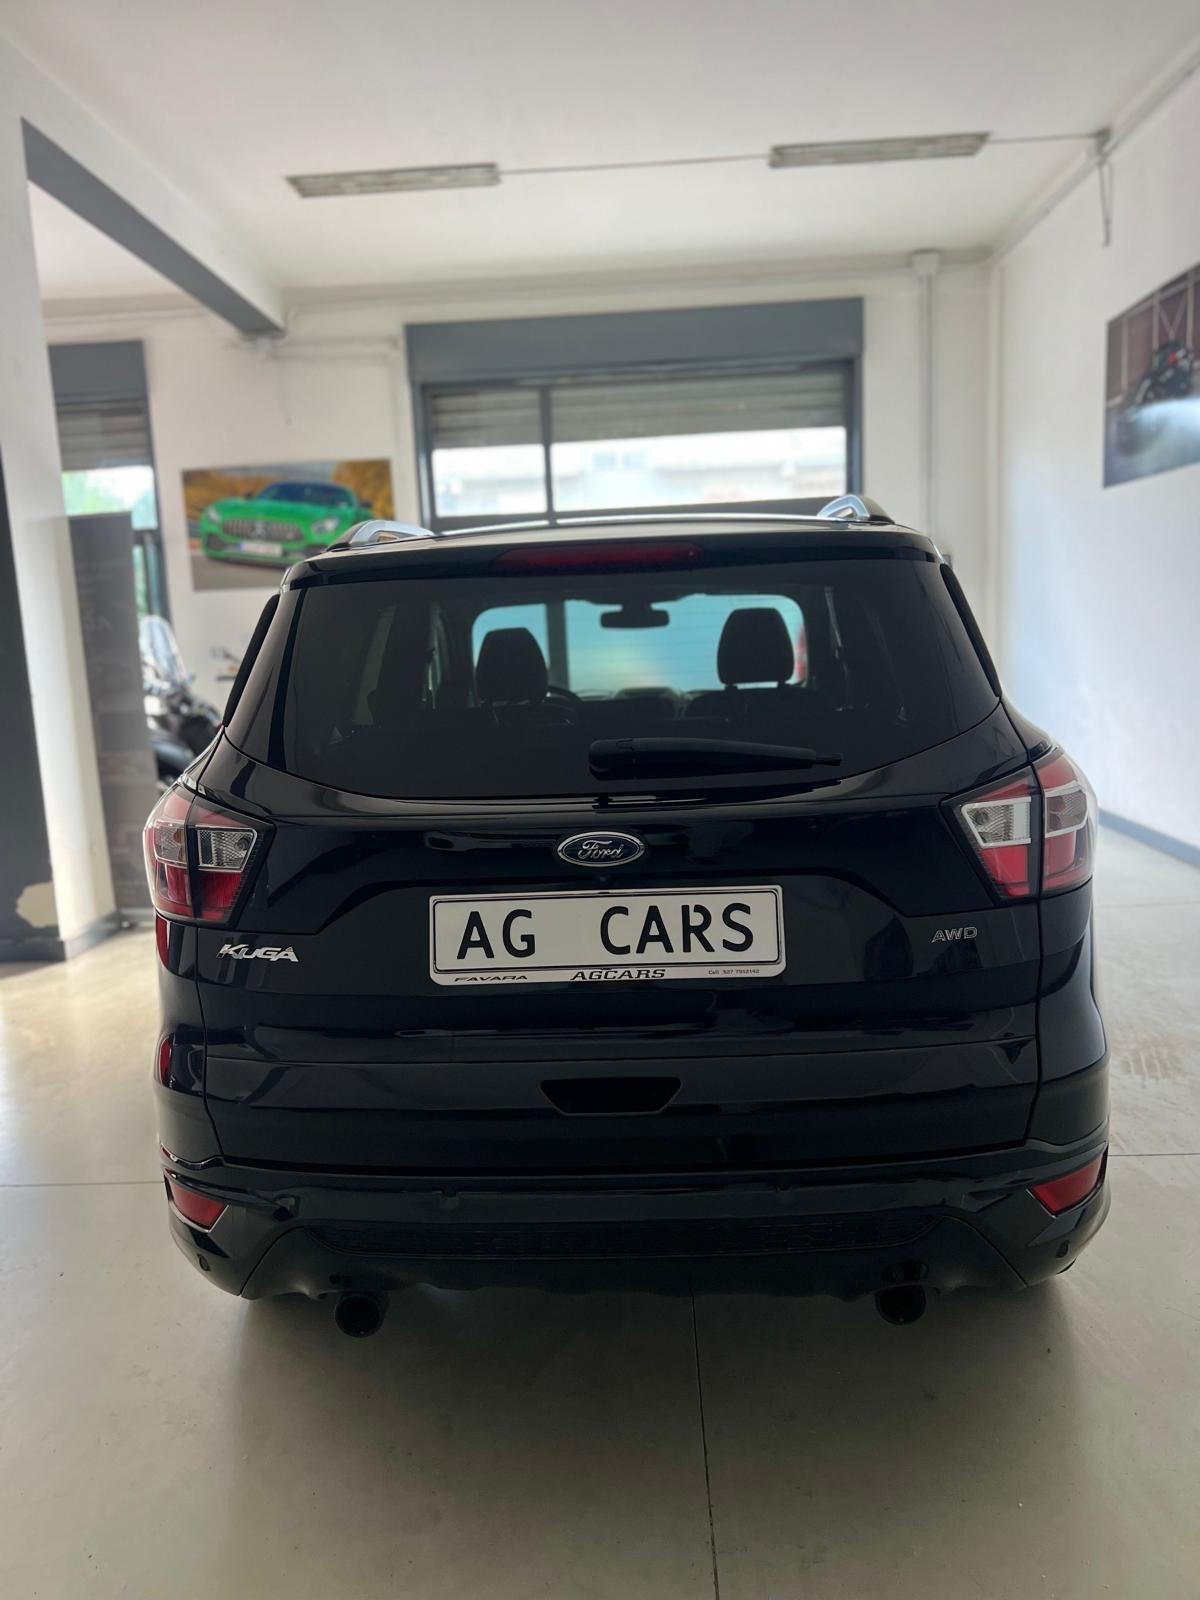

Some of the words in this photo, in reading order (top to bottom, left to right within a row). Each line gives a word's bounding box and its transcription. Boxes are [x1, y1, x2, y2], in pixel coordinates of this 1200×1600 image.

[577, 839, 624, 859] Ford
[456, 908, 536, 960] AG
[600, 902, 754, 955] CARS
[931, 926, 978, 943] AWD
[216, 944, 299, 962] KUGA
[570, 969, 666, 981] AGCARS
